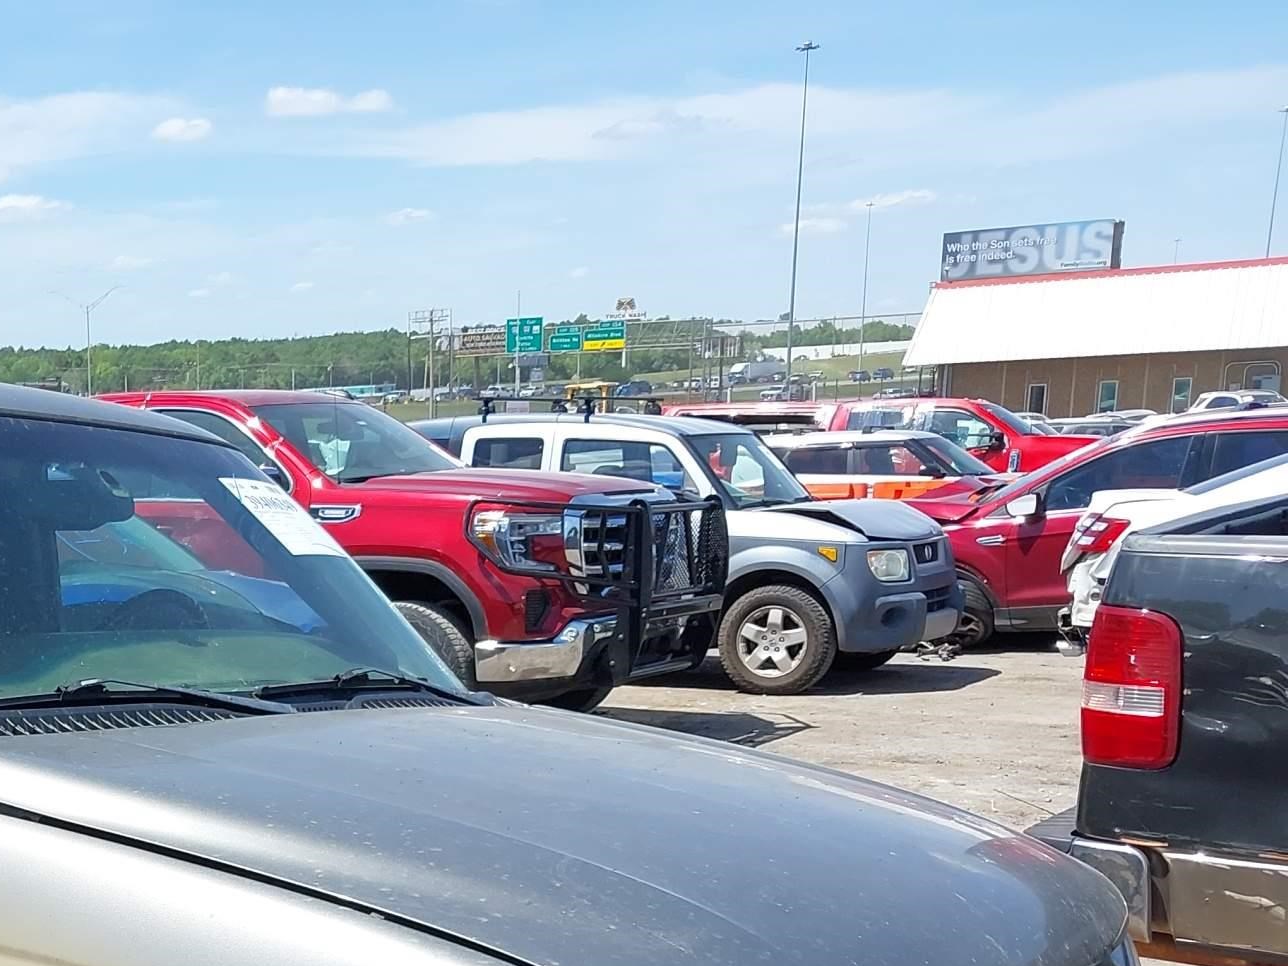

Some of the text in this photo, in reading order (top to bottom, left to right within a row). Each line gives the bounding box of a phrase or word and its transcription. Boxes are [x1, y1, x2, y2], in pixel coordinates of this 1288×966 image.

[946, 236, 1057, 253] Who the Son sets free
[946, 222, 1113, 278] JESUS
[956, 253, 976, 263] free
[978, 250, 1016, 262] indeed.
